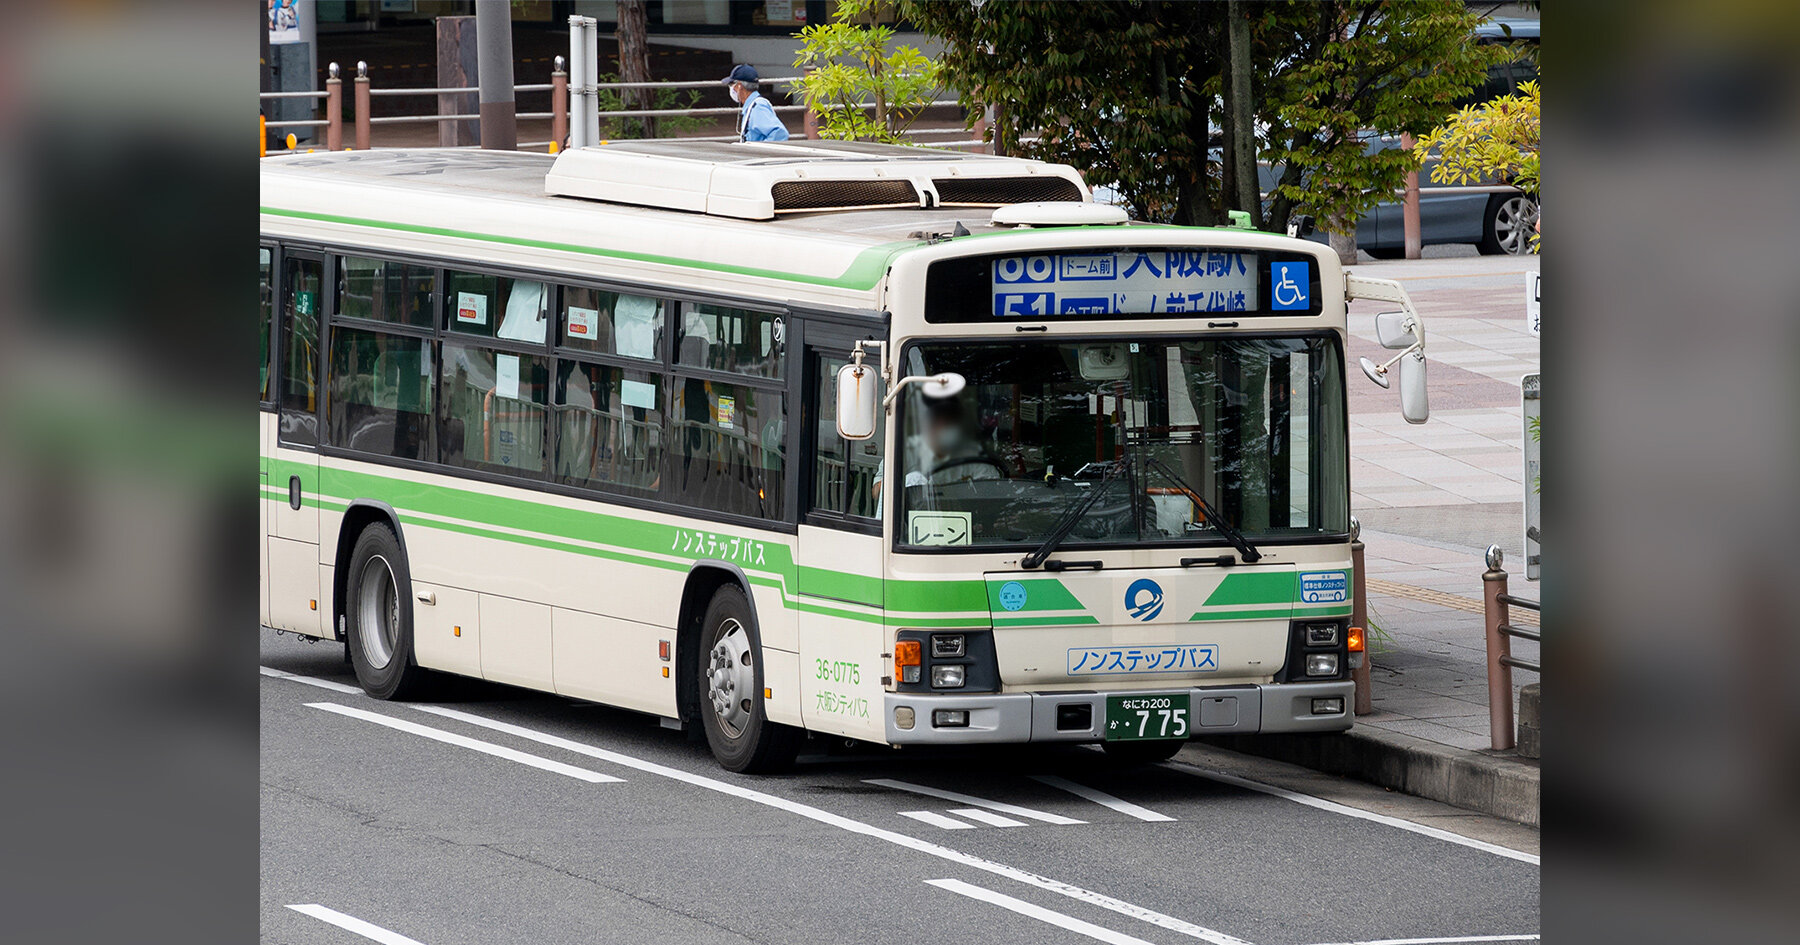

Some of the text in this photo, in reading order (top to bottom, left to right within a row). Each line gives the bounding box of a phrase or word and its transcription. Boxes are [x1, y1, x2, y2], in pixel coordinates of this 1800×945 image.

[1066, 259, 1111, 274] ドーム前
[672, 530, 766, 566] ノンステップバス
[914, 526, 966, 545] レーン
[1072, 647, 1216, 672] ノンステップバス
[816, 690, 870, 719] 大阪シティバス
